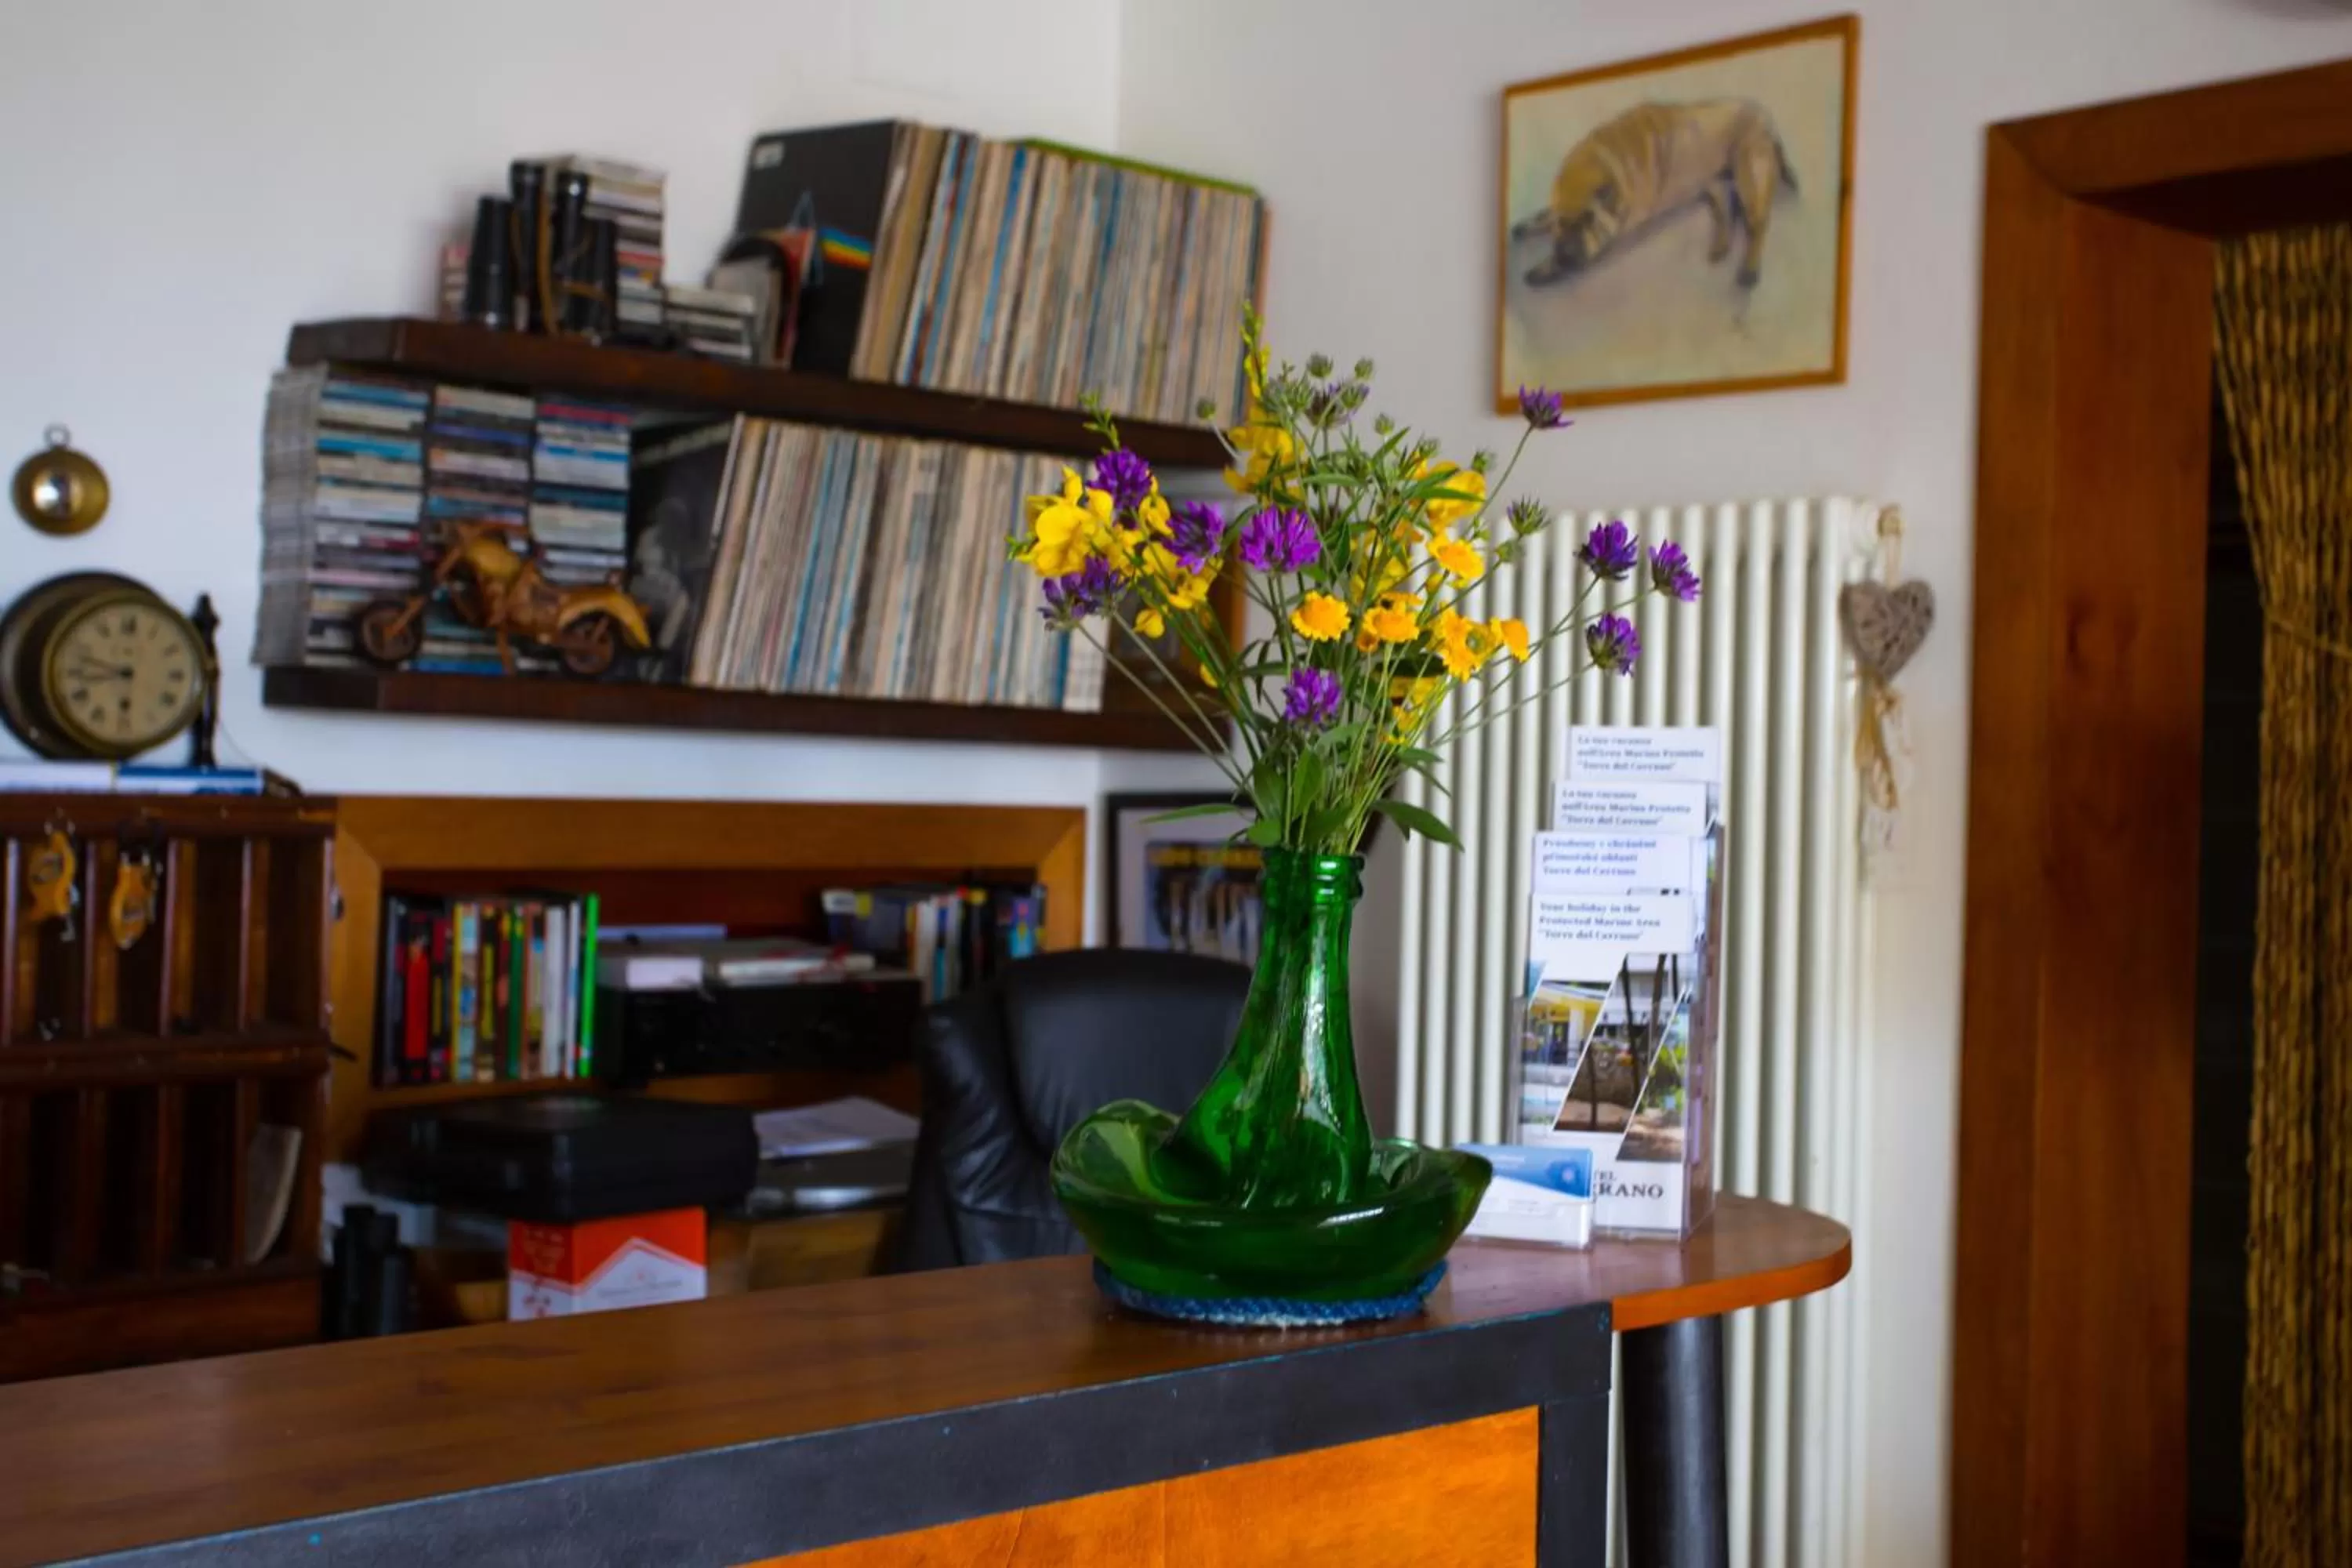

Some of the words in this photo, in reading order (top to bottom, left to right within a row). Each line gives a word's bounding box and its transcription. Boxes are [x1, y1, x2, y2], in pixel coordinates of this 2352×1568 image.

[1609, 804, 1645, 812] Marina
[1574, 866, 1590, 875] del
[1541, 903, 1564, 912] Your
[1567, 903, 1606, 915] holiday
[1610, 904, 1621, 913] in
[1623, 904, 1641, 913] the
[1539, 916, 1592, 926] Protected
[1595, 917, 1632, 927] Marine
[1636, 919, 1661, 927] Area
[1576, 930, 1593, 940] del
[1593, 1181, 1664, 1200] RANO
